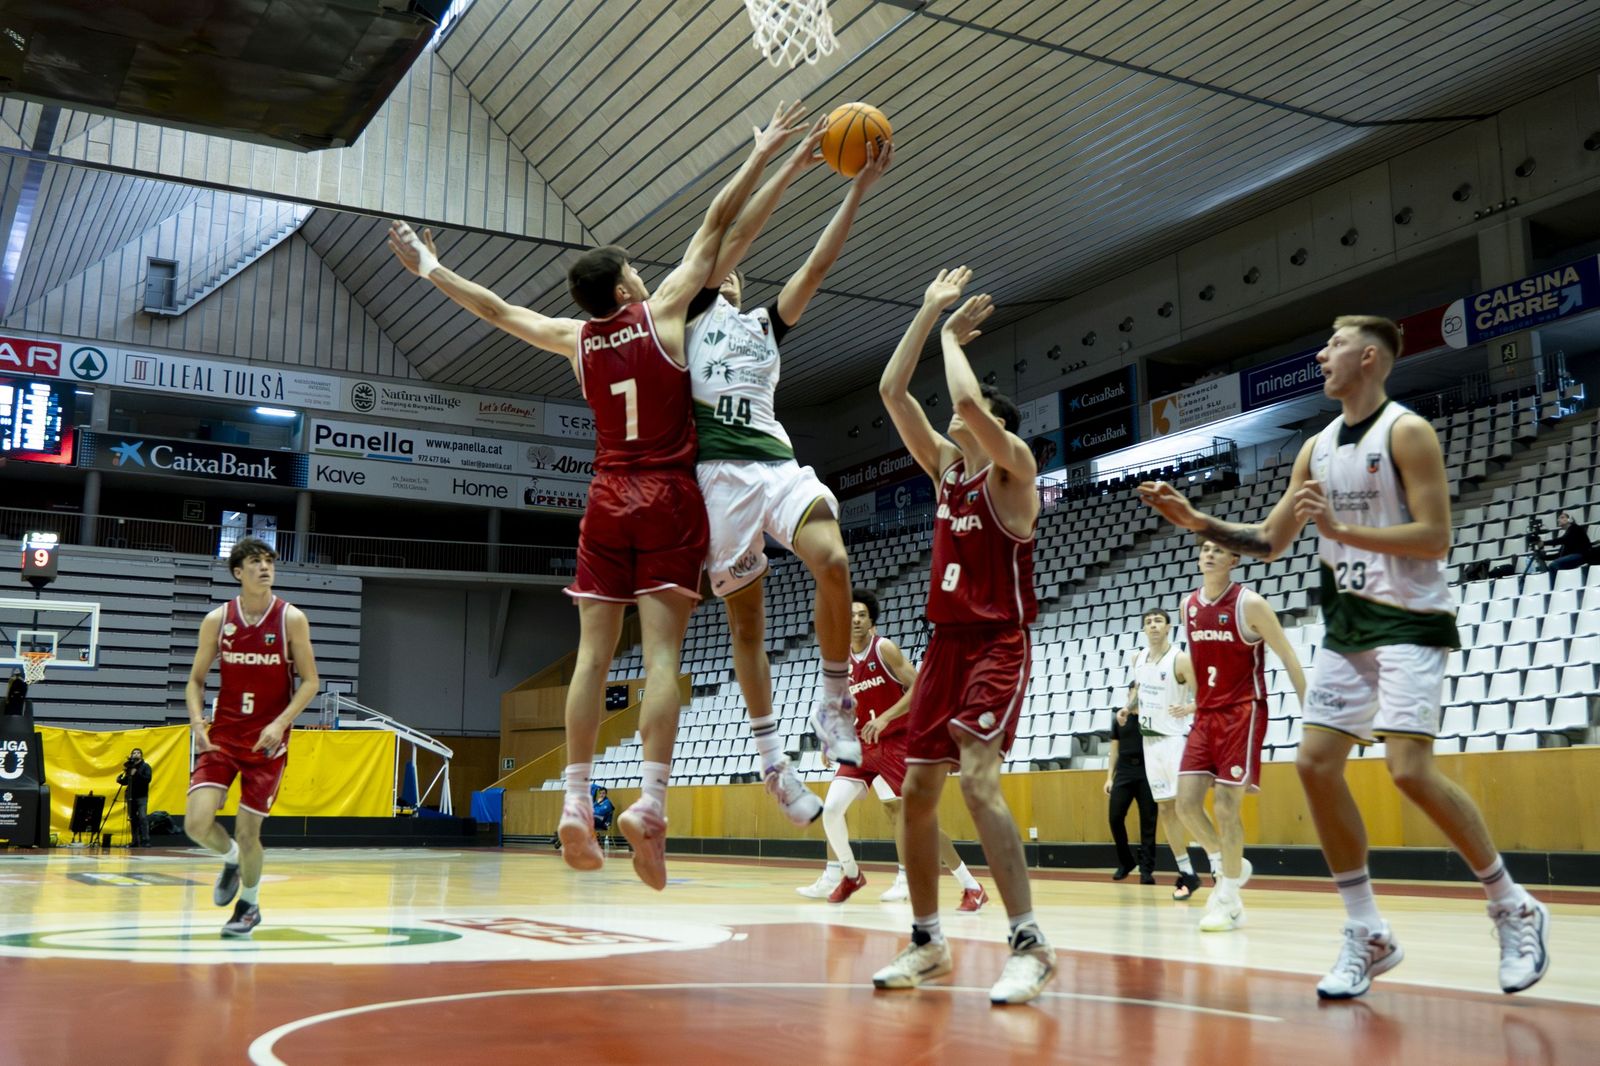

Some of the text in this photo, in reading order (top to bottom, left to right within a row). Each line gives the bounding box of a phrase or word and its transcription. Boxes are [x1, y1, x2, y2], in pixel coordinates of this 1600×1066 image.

[1474, 266, 1580, 312] CALSINA
[583, 323, 649, 354] POL COLL
[159, 361, 284, 400] LLEAL TULSÀ
[1081, 382, 1125, 407] CaixaBank
[423, 394, 462, 408] village
[479, 401, 498, 411] Let's
[714, 395, 752, 426] 44
[315, 424, 503, 455] Panella www.panella.cat
[1082, 423, 1127, 447] CaixaBank
[150, 445, 278, 480] CaixaBank
[840, 468, 863, 490] Diari
[865, 464, 878, 480] de
[879, 454, 914, 476] Girona
[316, 464, 508, 499] Kave Home
[34, 549, 49, 567] 9
[941, 562, 961, 592] 9
[1336, 561, 1367, 591] 23
[222, 651, 281, 665] GIRONA
[1207, 665, 1217, 687] 2
[241, 692, 255, 714] 5
[1142, 716, 1152, 729] 21
